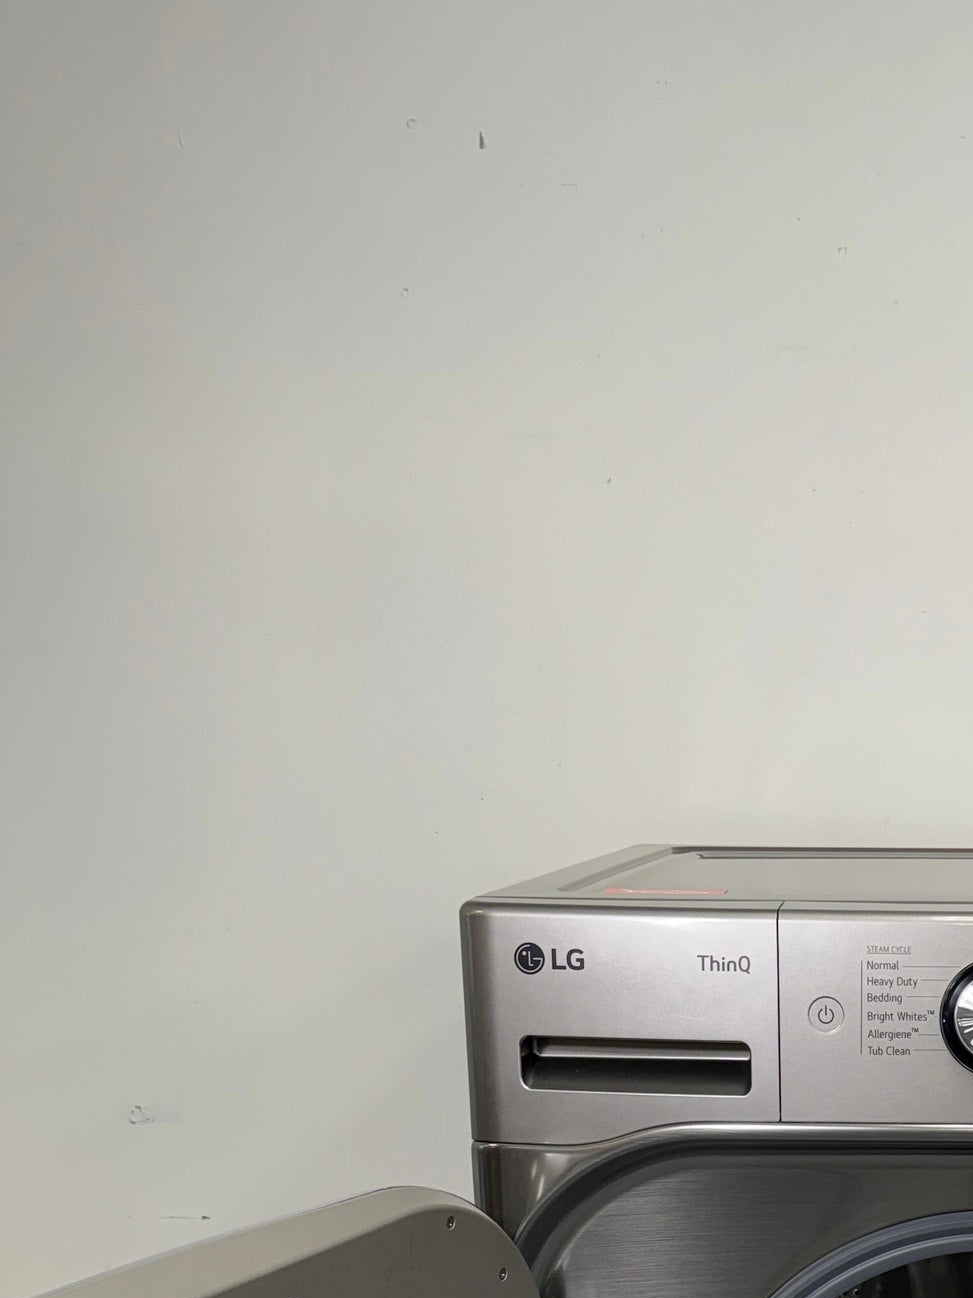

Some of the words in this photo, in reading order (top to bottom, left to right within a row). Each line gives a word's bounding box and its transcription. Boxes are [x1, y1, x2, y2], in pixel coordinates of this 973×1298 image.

[866, 945, 890, 954] STEAM
[891, 946, 911, 954] CYCLE
[551, 948, 585, 971] LG
[697, 955, 751, 975] ThinQ
[866, 961, 899, 970] Normal
[867, 977, 893, 988] Heavy
[896, 977, 918, 988] Duty
[867, 993, 902, 1005] Bedding
[867, 1012, 894, 1023] Bright
[868, 1046, 883, 1056] Tub
[886, 1047, 911, 1056] Clean
